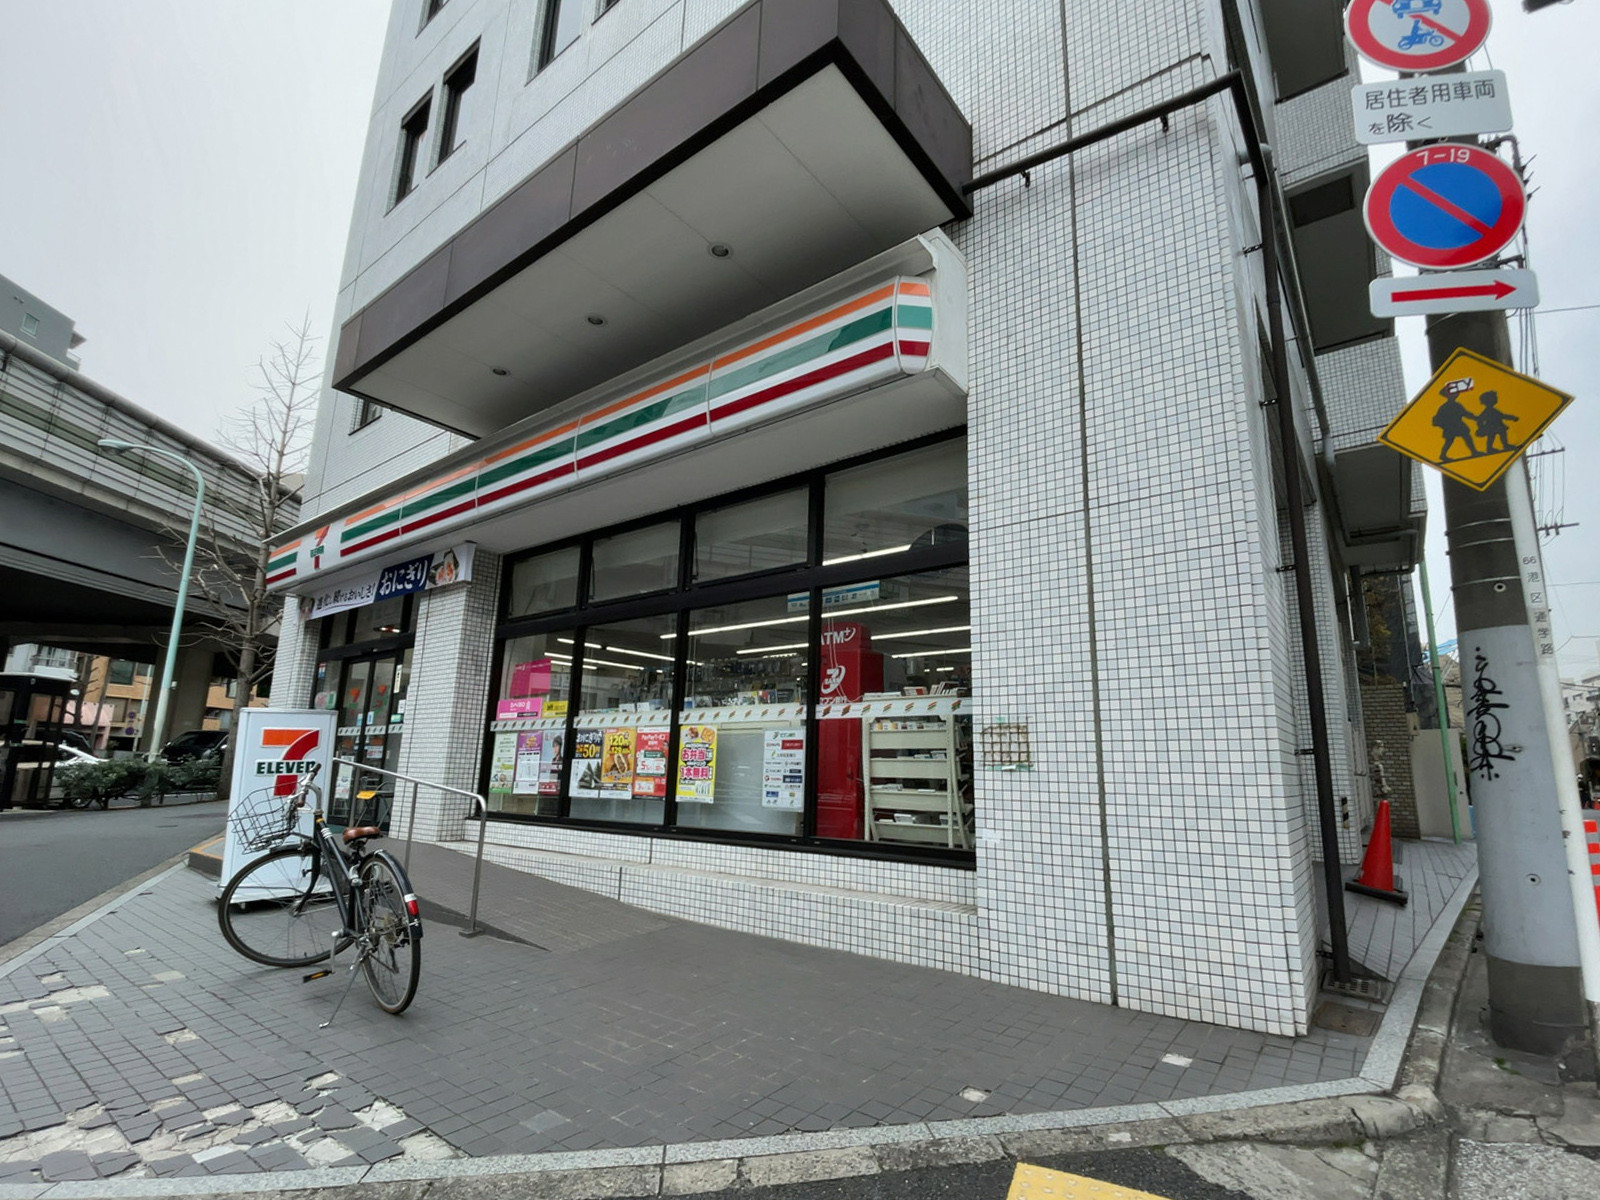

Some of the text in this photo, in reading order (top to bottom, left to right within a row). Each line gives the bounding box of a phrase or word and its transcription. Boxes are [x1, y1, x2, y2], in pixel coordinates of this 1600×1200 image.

[1365, 79, 1496, 111] 居住者用車両
[1368, 113, 1433, 136] を除く
[1416, 148, 1470, 165] 7-19
[379, 559, 428, 597] おにぎり
